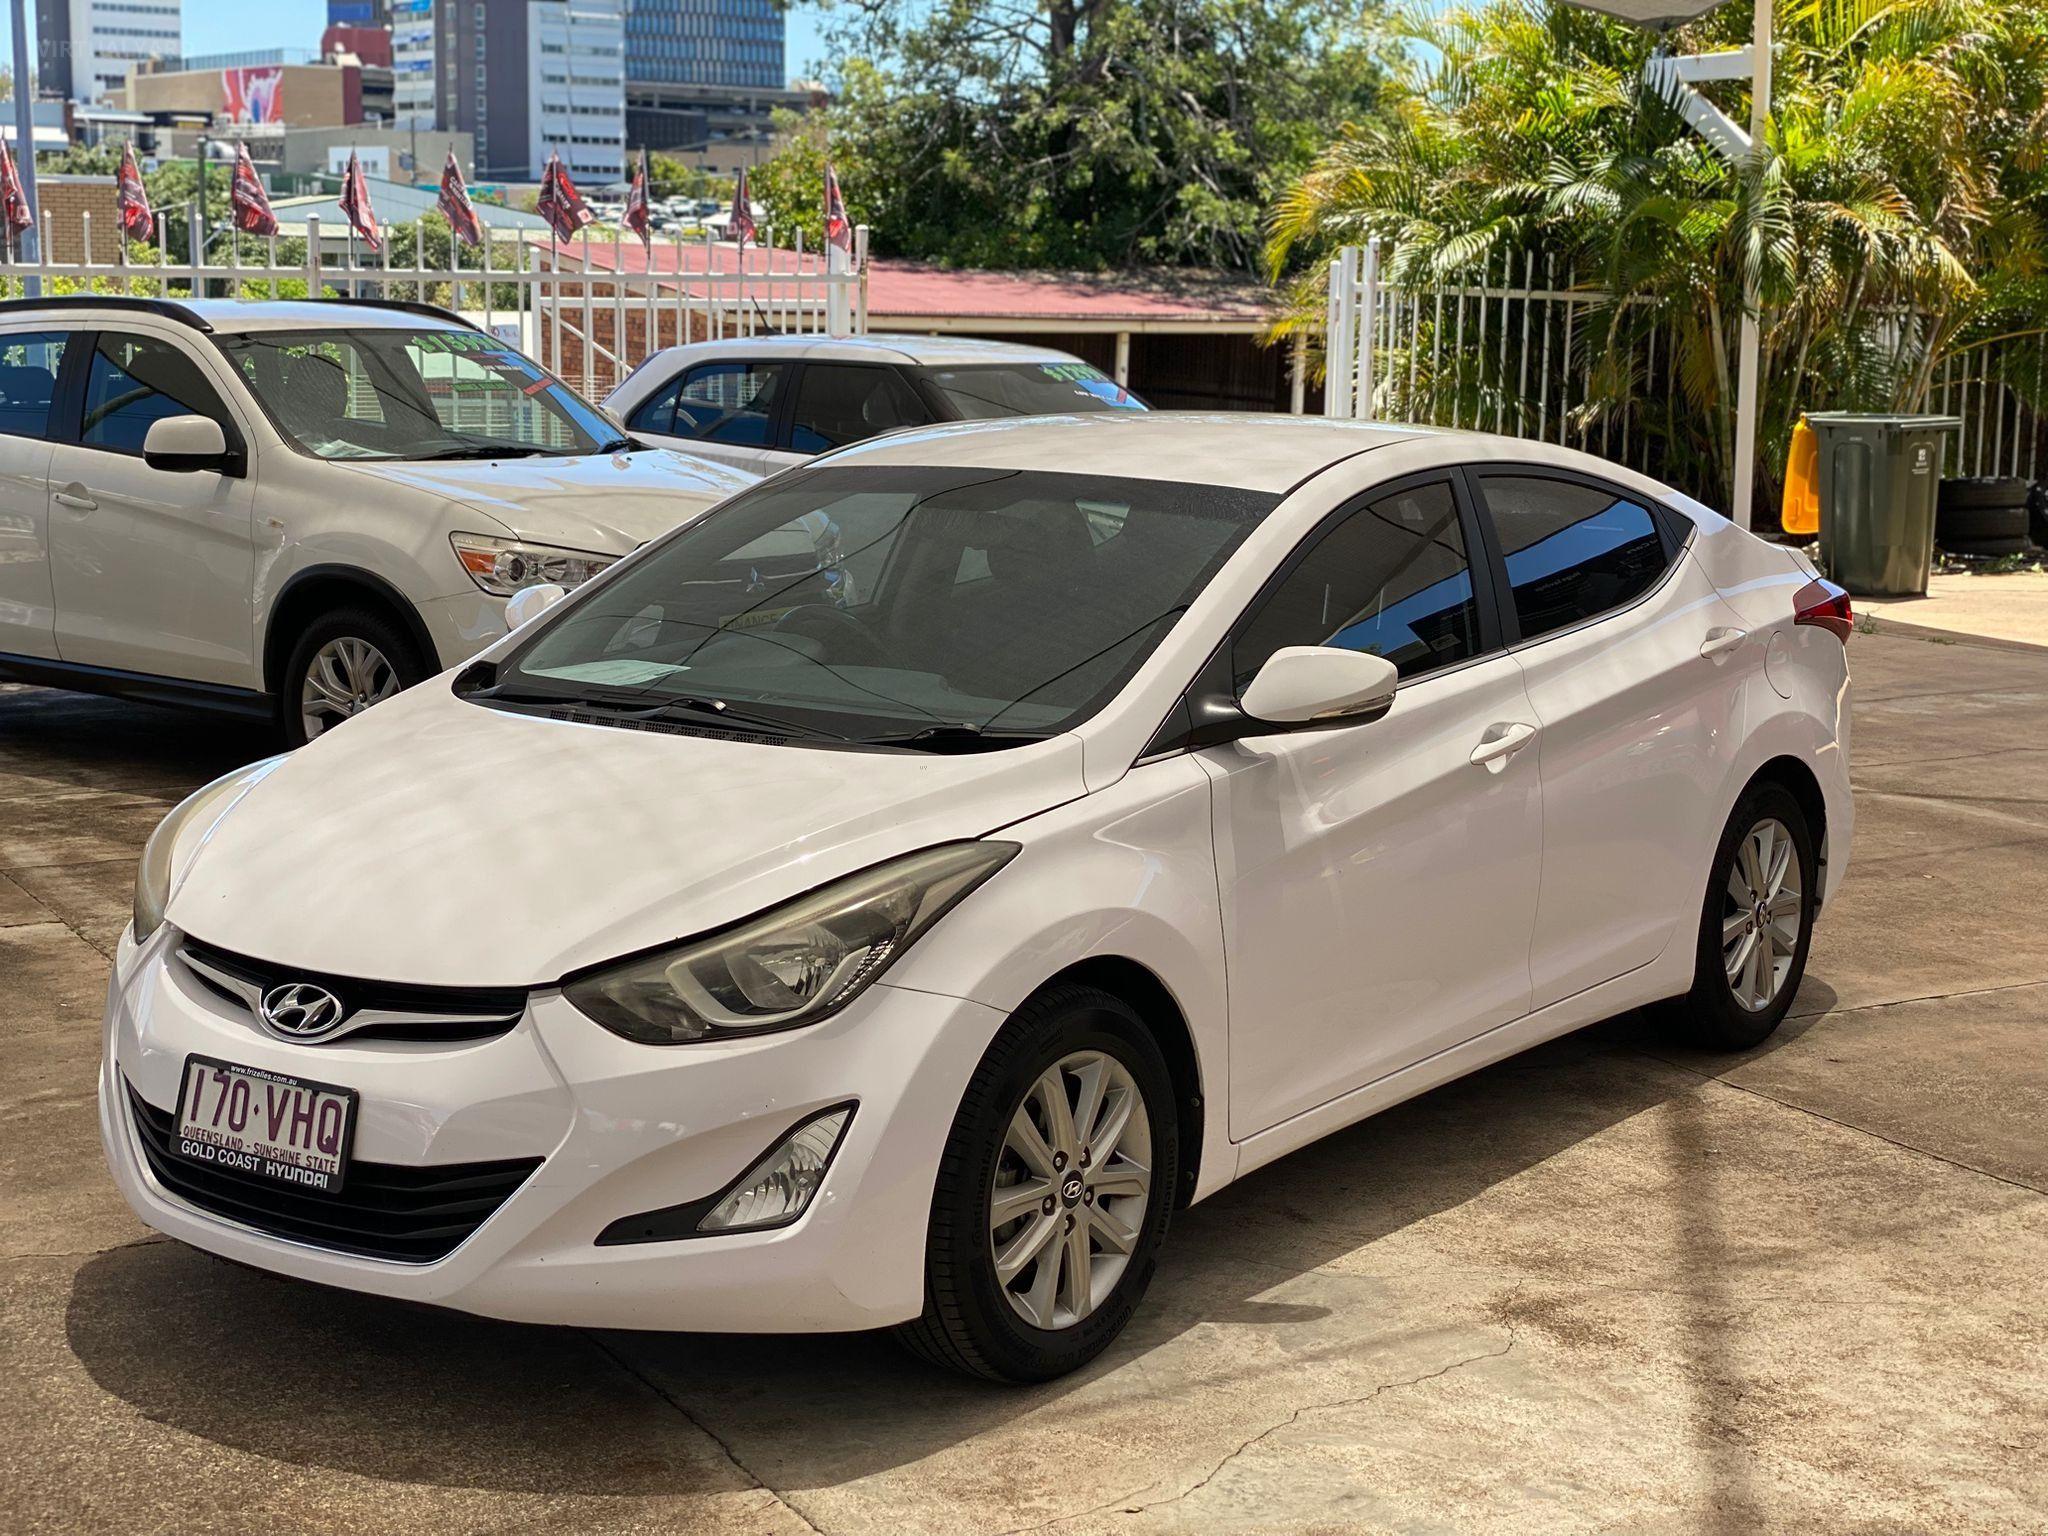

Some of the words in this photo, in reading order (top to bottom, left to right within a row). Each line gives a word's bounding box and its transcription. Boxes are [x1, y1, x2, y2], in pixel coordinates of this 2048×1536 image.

[230, 1065, 298, 1086] www.frizelles.com.au
[181, 1140, 215, 1163] GOLD
[217, 1148, 260, 1171] COAST
[266, 1160, 328, 1189] HYUNDAI
[183, 1125, 243, 1150] QUEENSLAND
[253, 1142, 301, 1166] SUNSHINE
[306, 1156, 336, 1173] STATE
